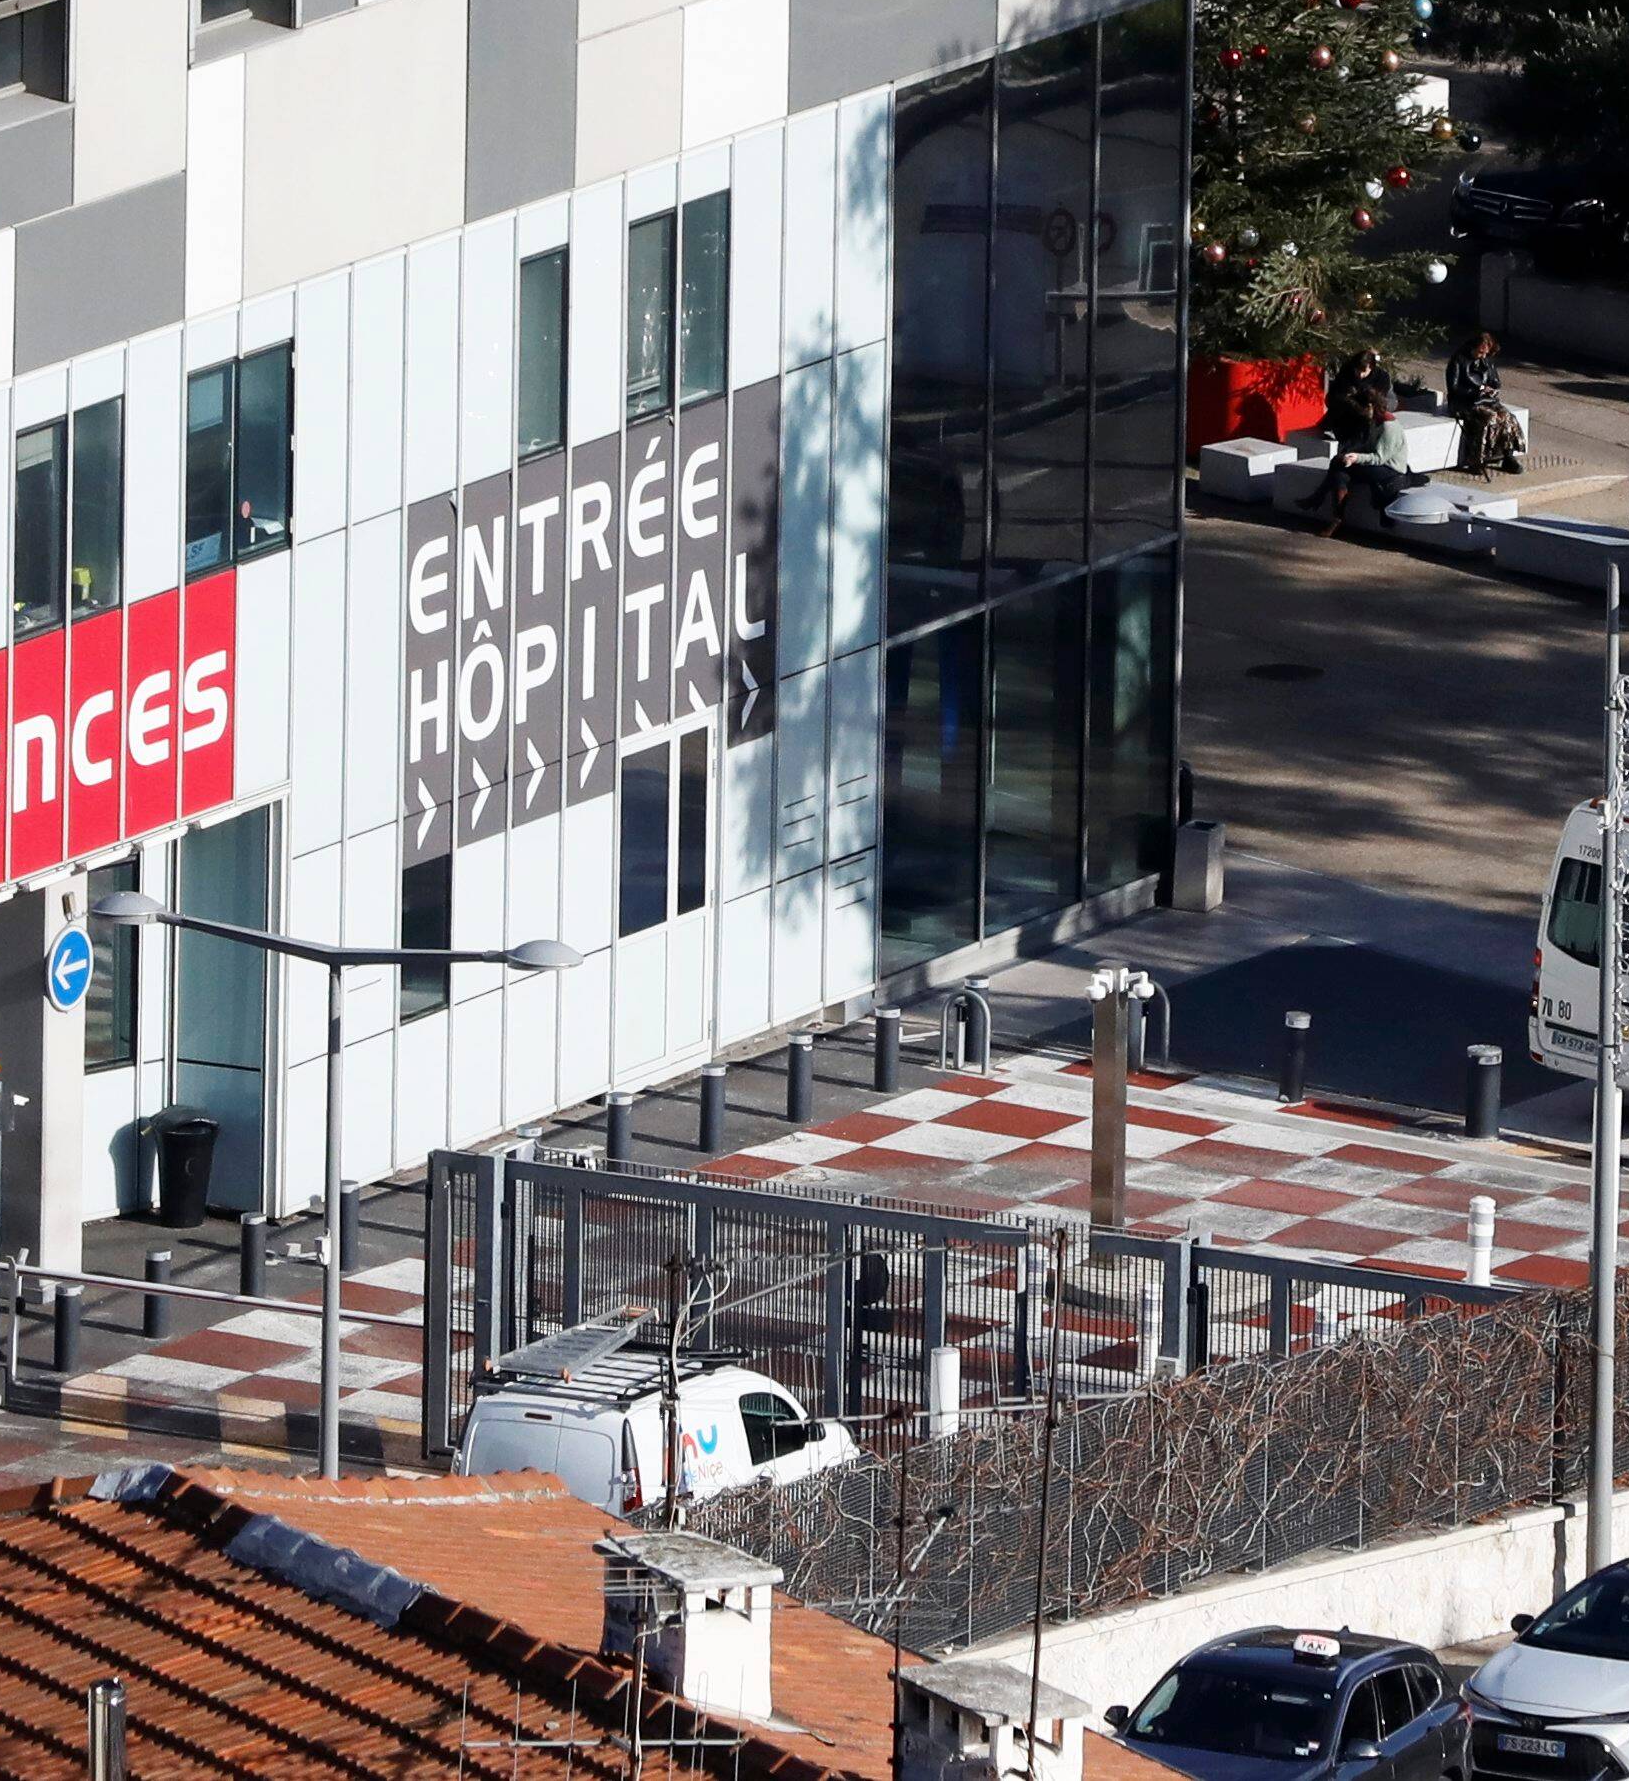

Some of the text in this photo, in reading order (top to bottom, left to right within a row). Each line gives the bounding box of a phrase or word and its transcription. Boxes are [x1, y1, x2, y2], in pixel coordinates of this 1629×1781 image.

[409, 436, 719, 634] ENTRÉE
[410, 552, 766, 763] HÔPITAL
[1542, 997, 1571, 1020] 70 80
[1302, 1640, 1326, 1652] TAXI
